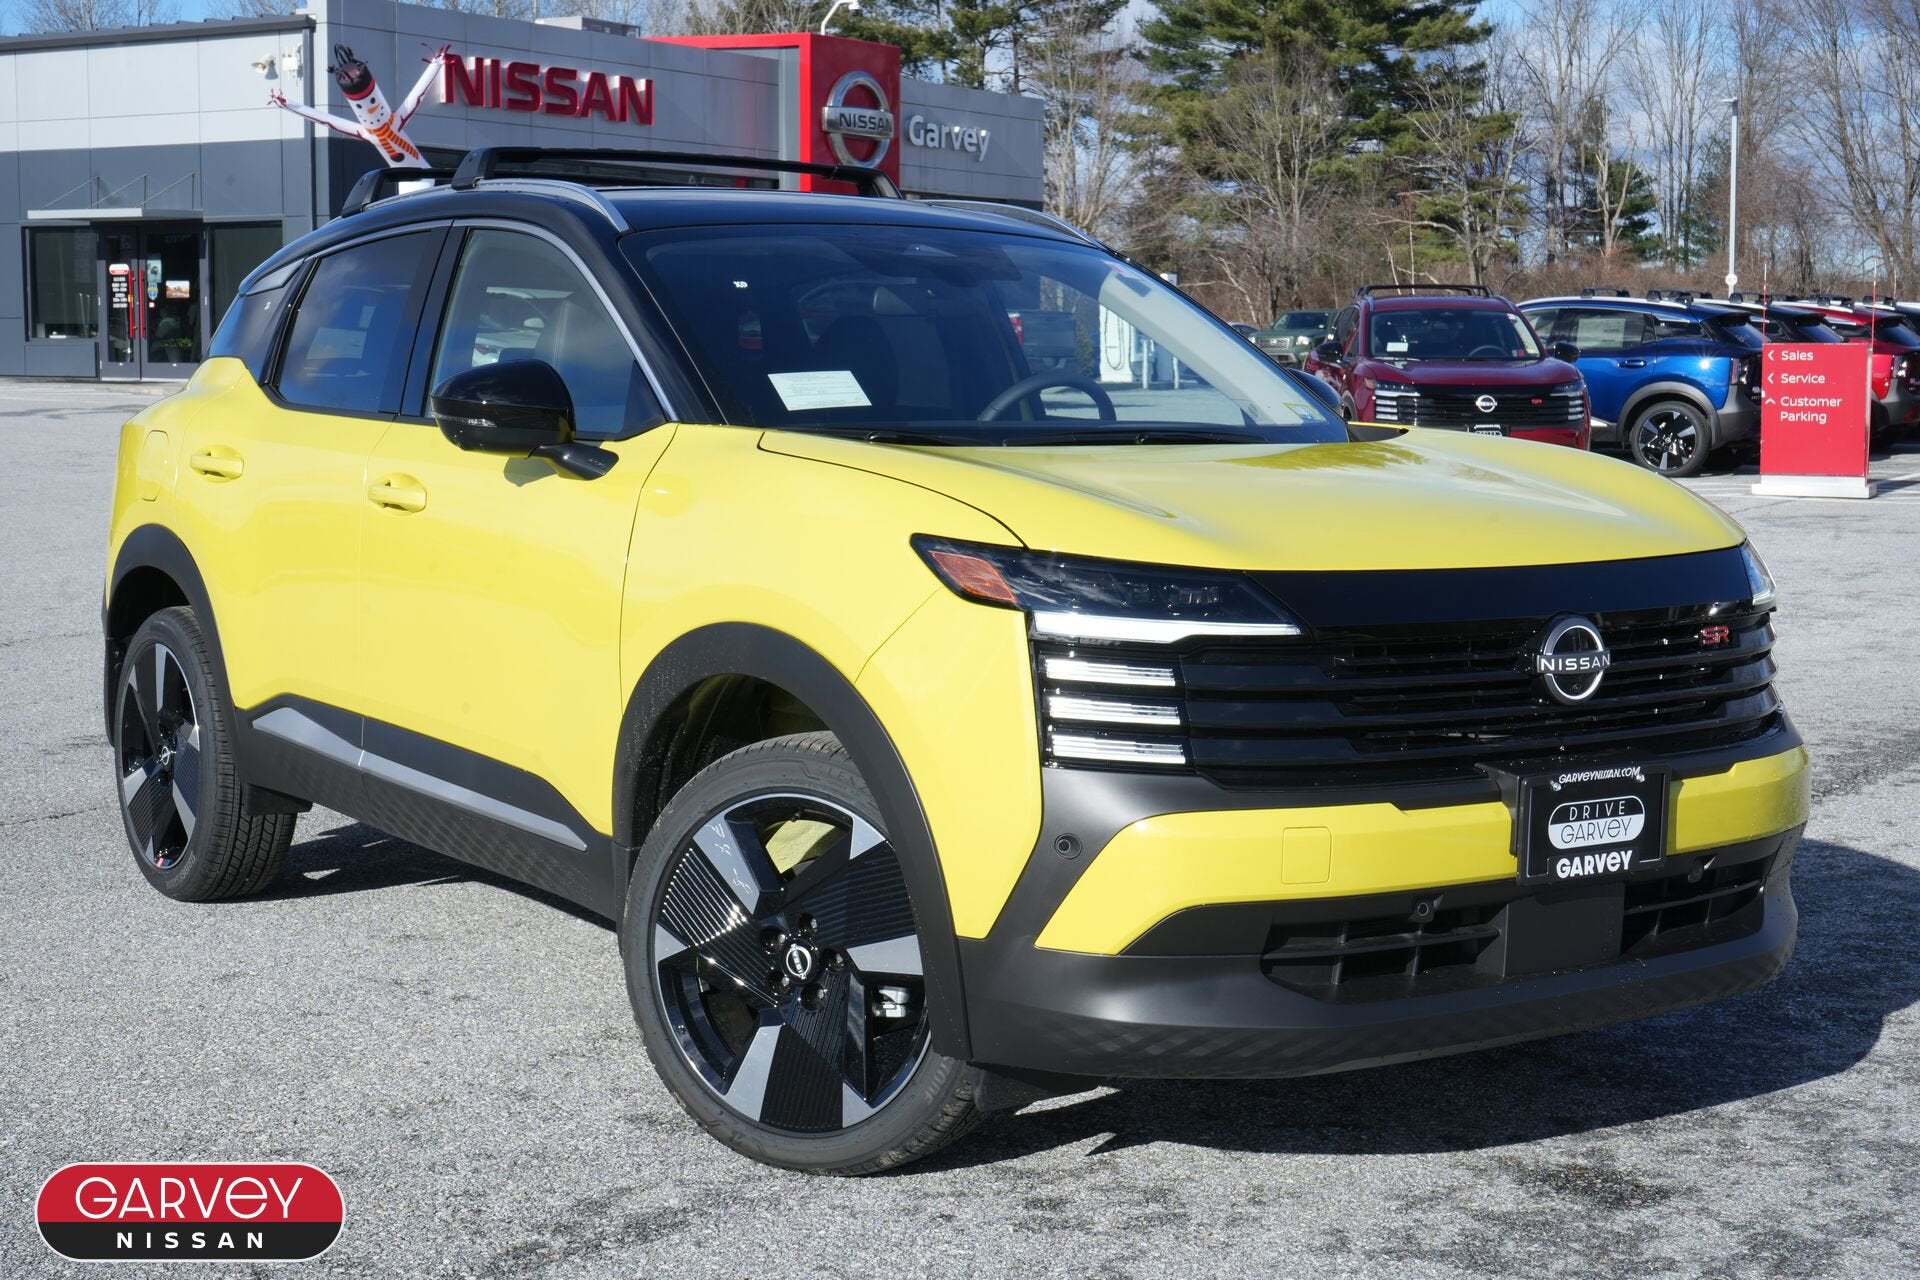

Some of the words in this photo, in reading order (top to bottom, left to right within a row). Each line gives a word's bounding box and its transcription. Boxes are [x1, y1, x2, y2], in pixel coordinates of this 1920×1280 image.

[443, 53, 654, 126] NISSAN
[839, 112, 892, 132] NISSAN
[908, 114, 991, 162] Garvey
[1781, 350, 1814, 361] Sales
[1780, 373, 1826, 384] Service
[1780, 396, 1843, 407] Customer
[1780, 411, 1827, 425] Parking
[1701, 626, 1729, 645] SR
[1540, 653, 1611, 672] NISSAN
[1569, 800, 1627, 821] DRIVE
